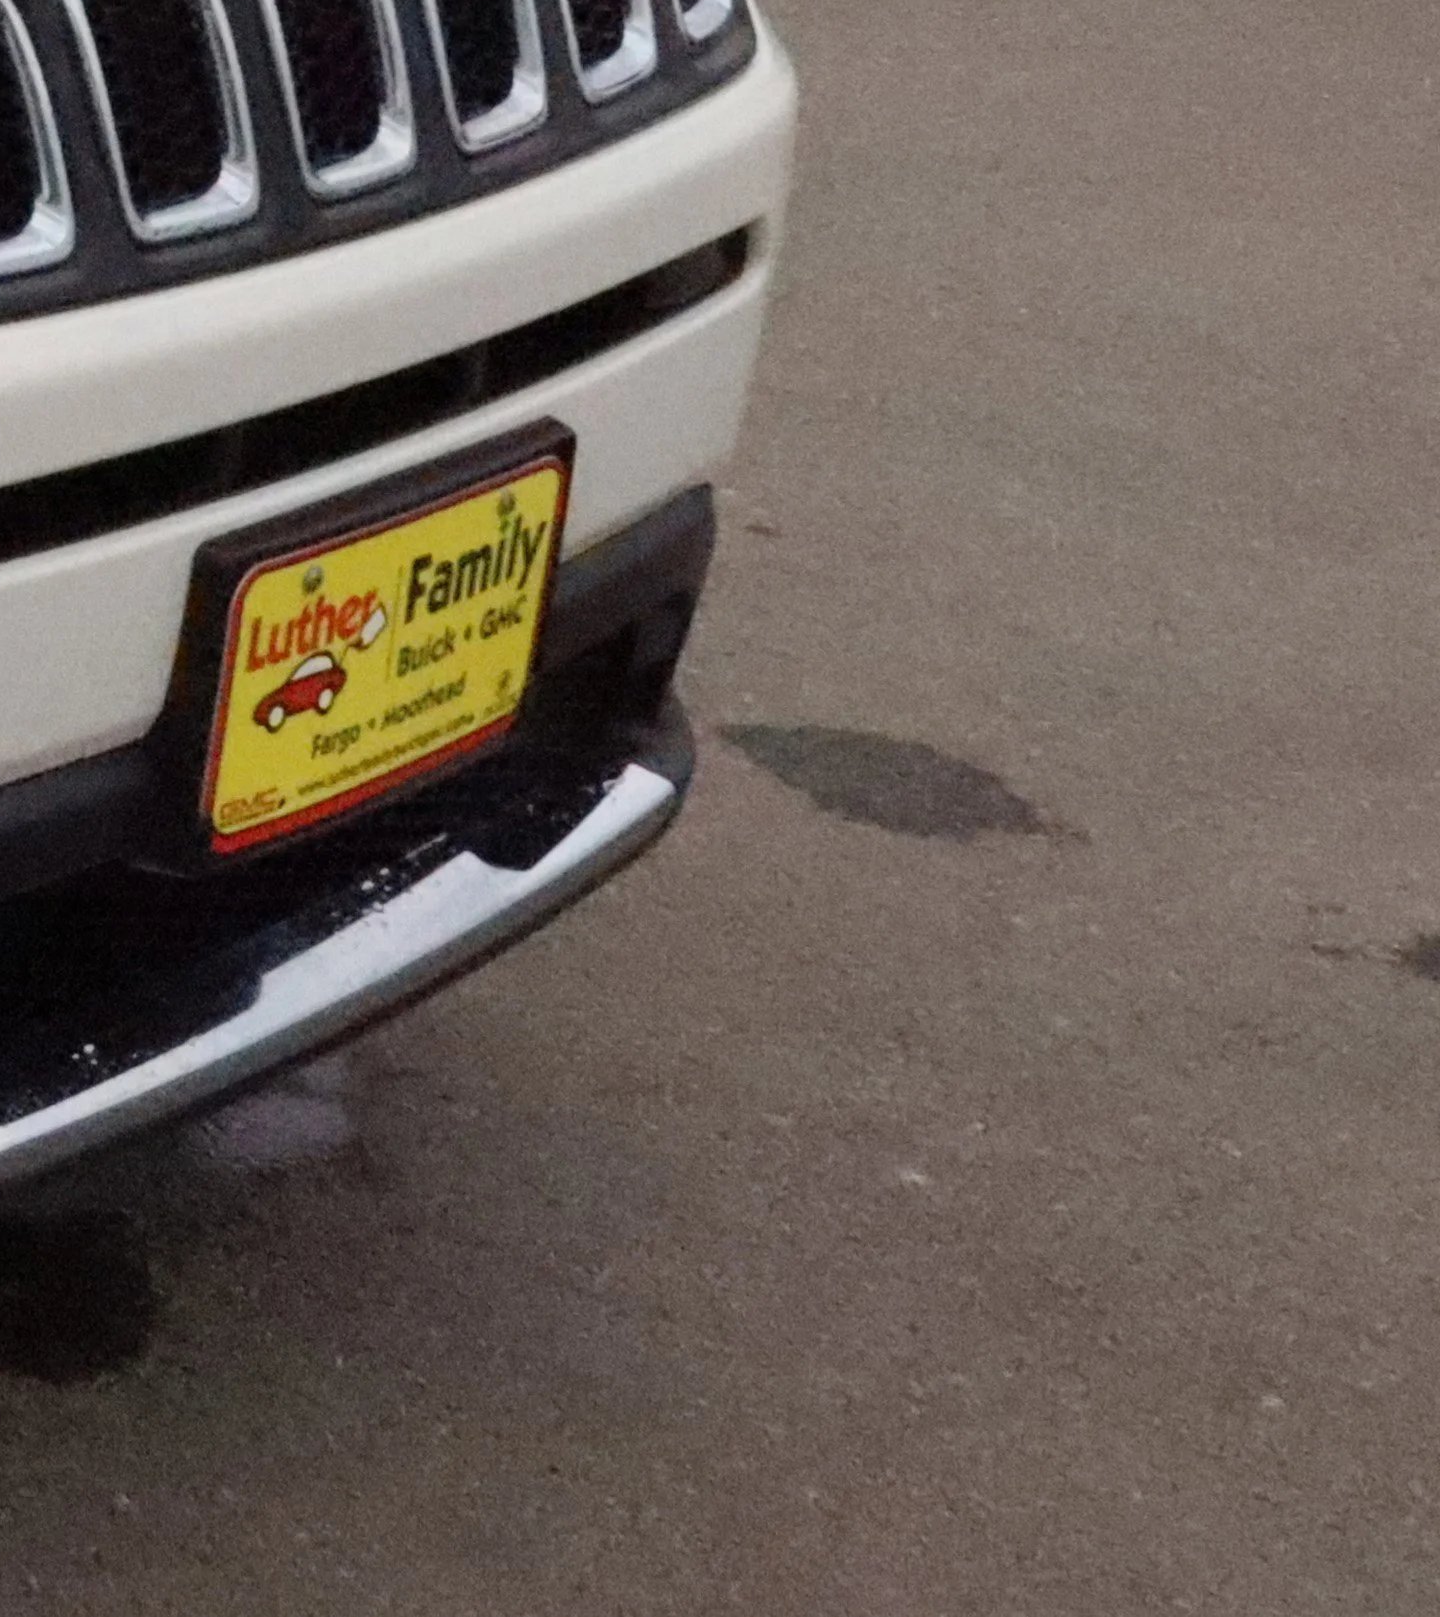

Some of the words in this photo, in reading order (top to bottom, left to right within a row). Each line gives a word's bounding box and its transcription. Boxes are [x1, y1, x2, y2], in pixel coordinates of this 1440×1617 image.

[404, 518, 548, 624] Family
[246, 588, 378, 673] Luther
[396, 624, 456, 678] Buick
[479, 595, 528, 640] GMC
[310, 724, 362, 760] Fargo
